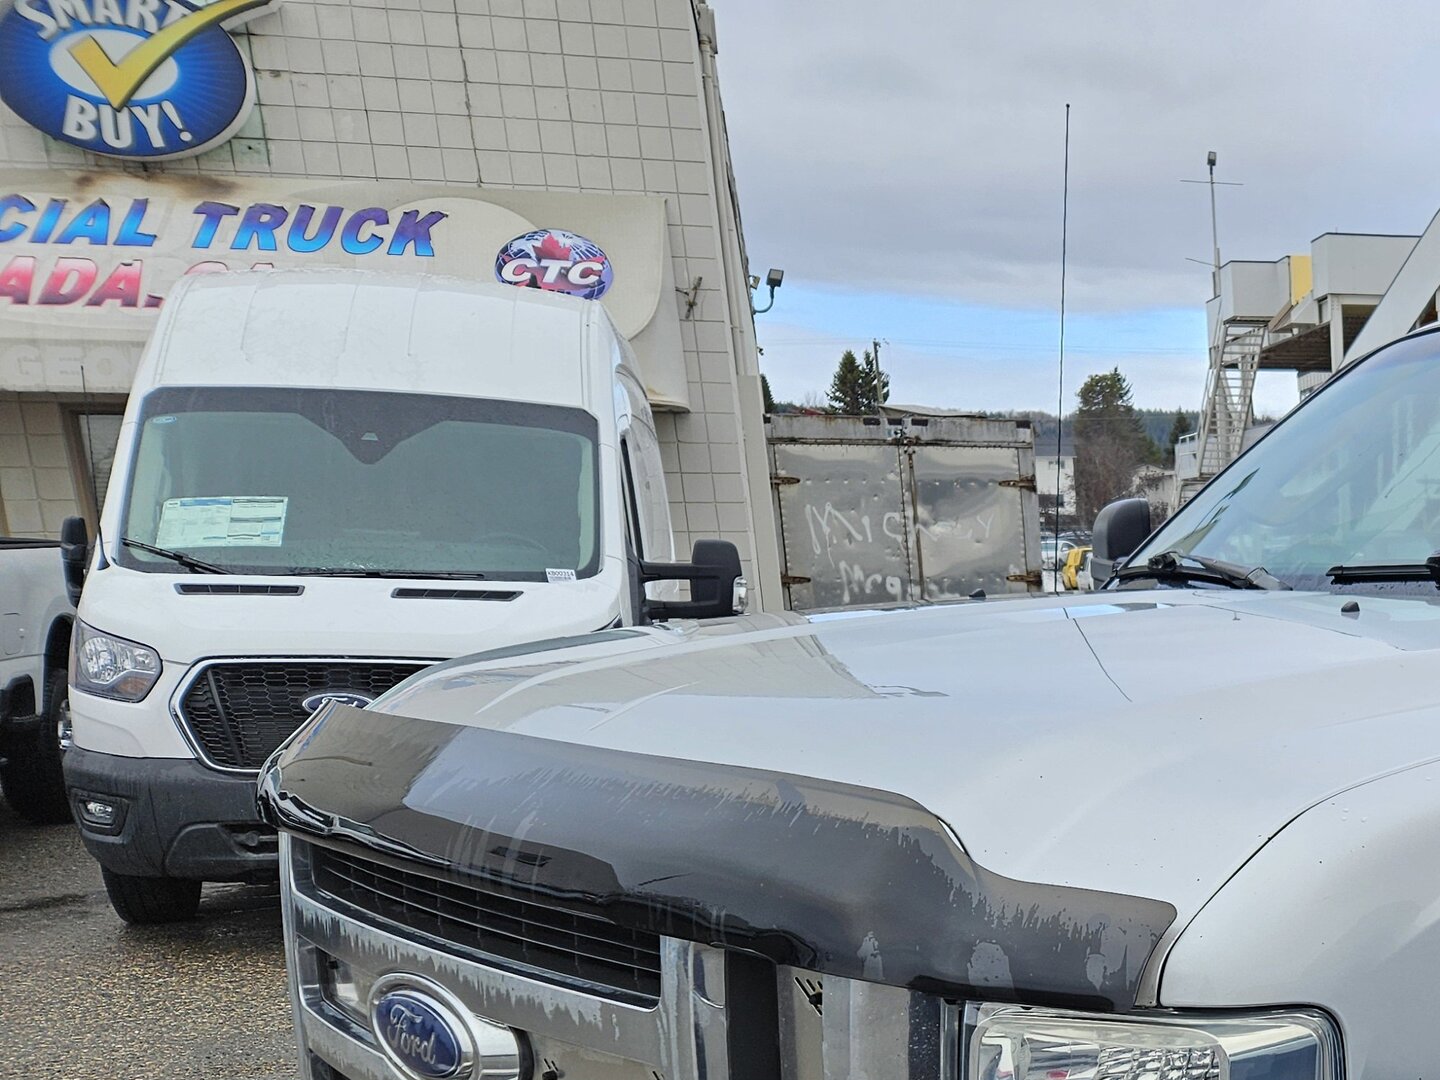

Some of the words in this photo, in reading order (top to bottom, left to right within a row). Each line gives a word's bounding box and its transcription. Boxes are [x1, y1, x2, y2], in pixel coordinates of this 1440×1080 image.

[62, 94, 192, 149] BUY!
[191, 200, 449, 257] TRUCK
[500, 257, 604, 286] CTC
[386, 1003, 437, 1066] Ford
